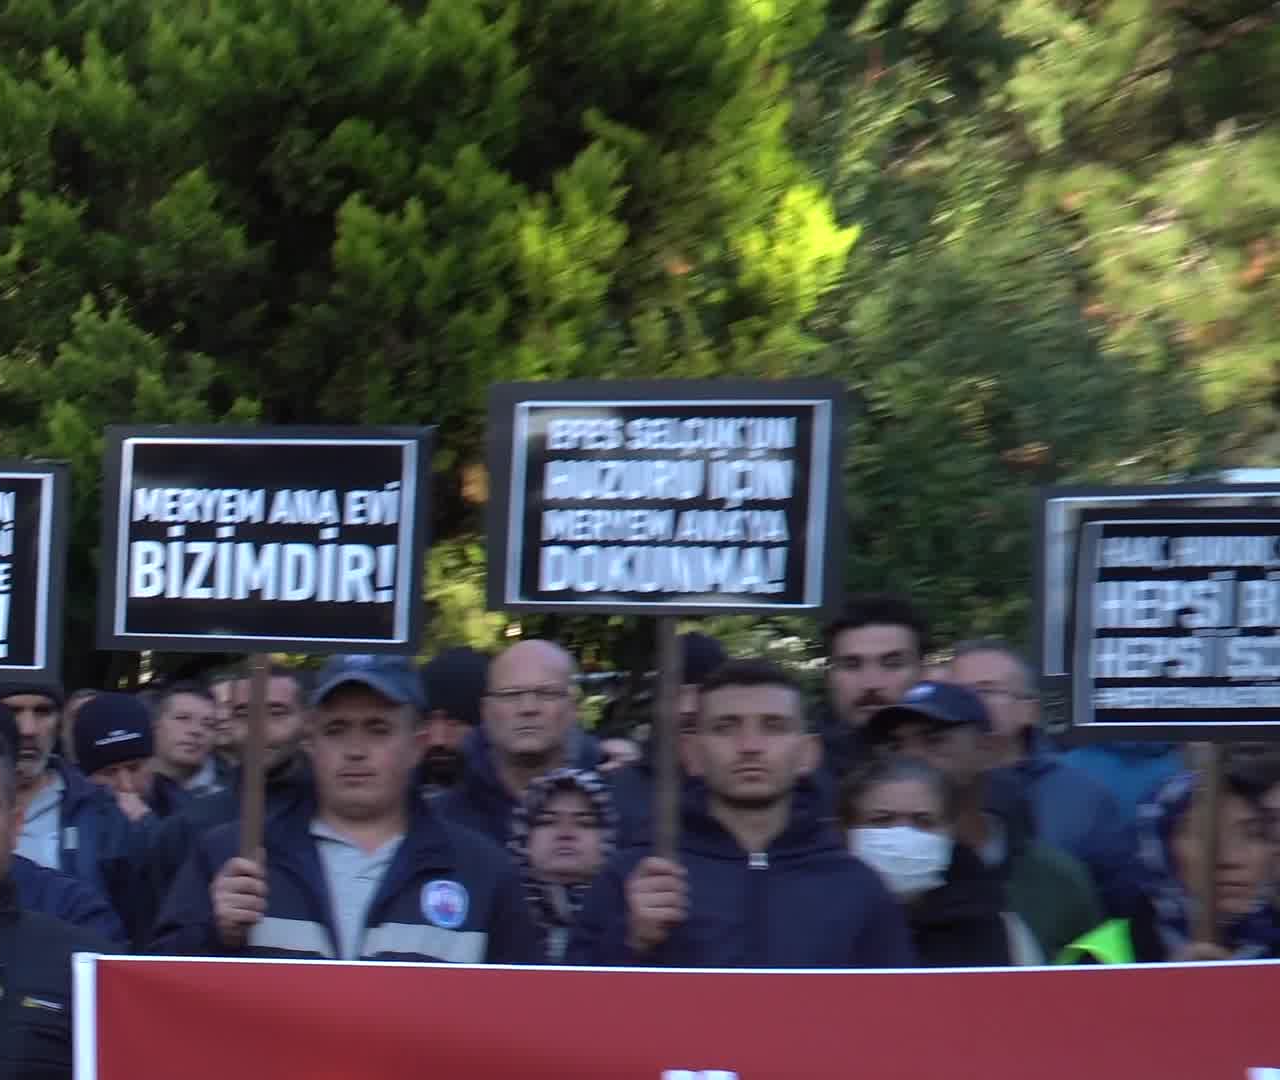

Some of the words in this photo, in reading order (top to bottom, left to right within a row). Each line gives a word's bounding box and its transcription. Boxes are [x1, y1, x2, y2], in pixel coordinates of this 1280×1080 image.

[132, 488, 266, 524] MERYEM
[267, 489, 339, 525] ANA
[343, 480, 401, 525] EVİ
[542, 509, 675, 541] MERYEM
[128, 525, 396, 603] BİZİMDİR!
